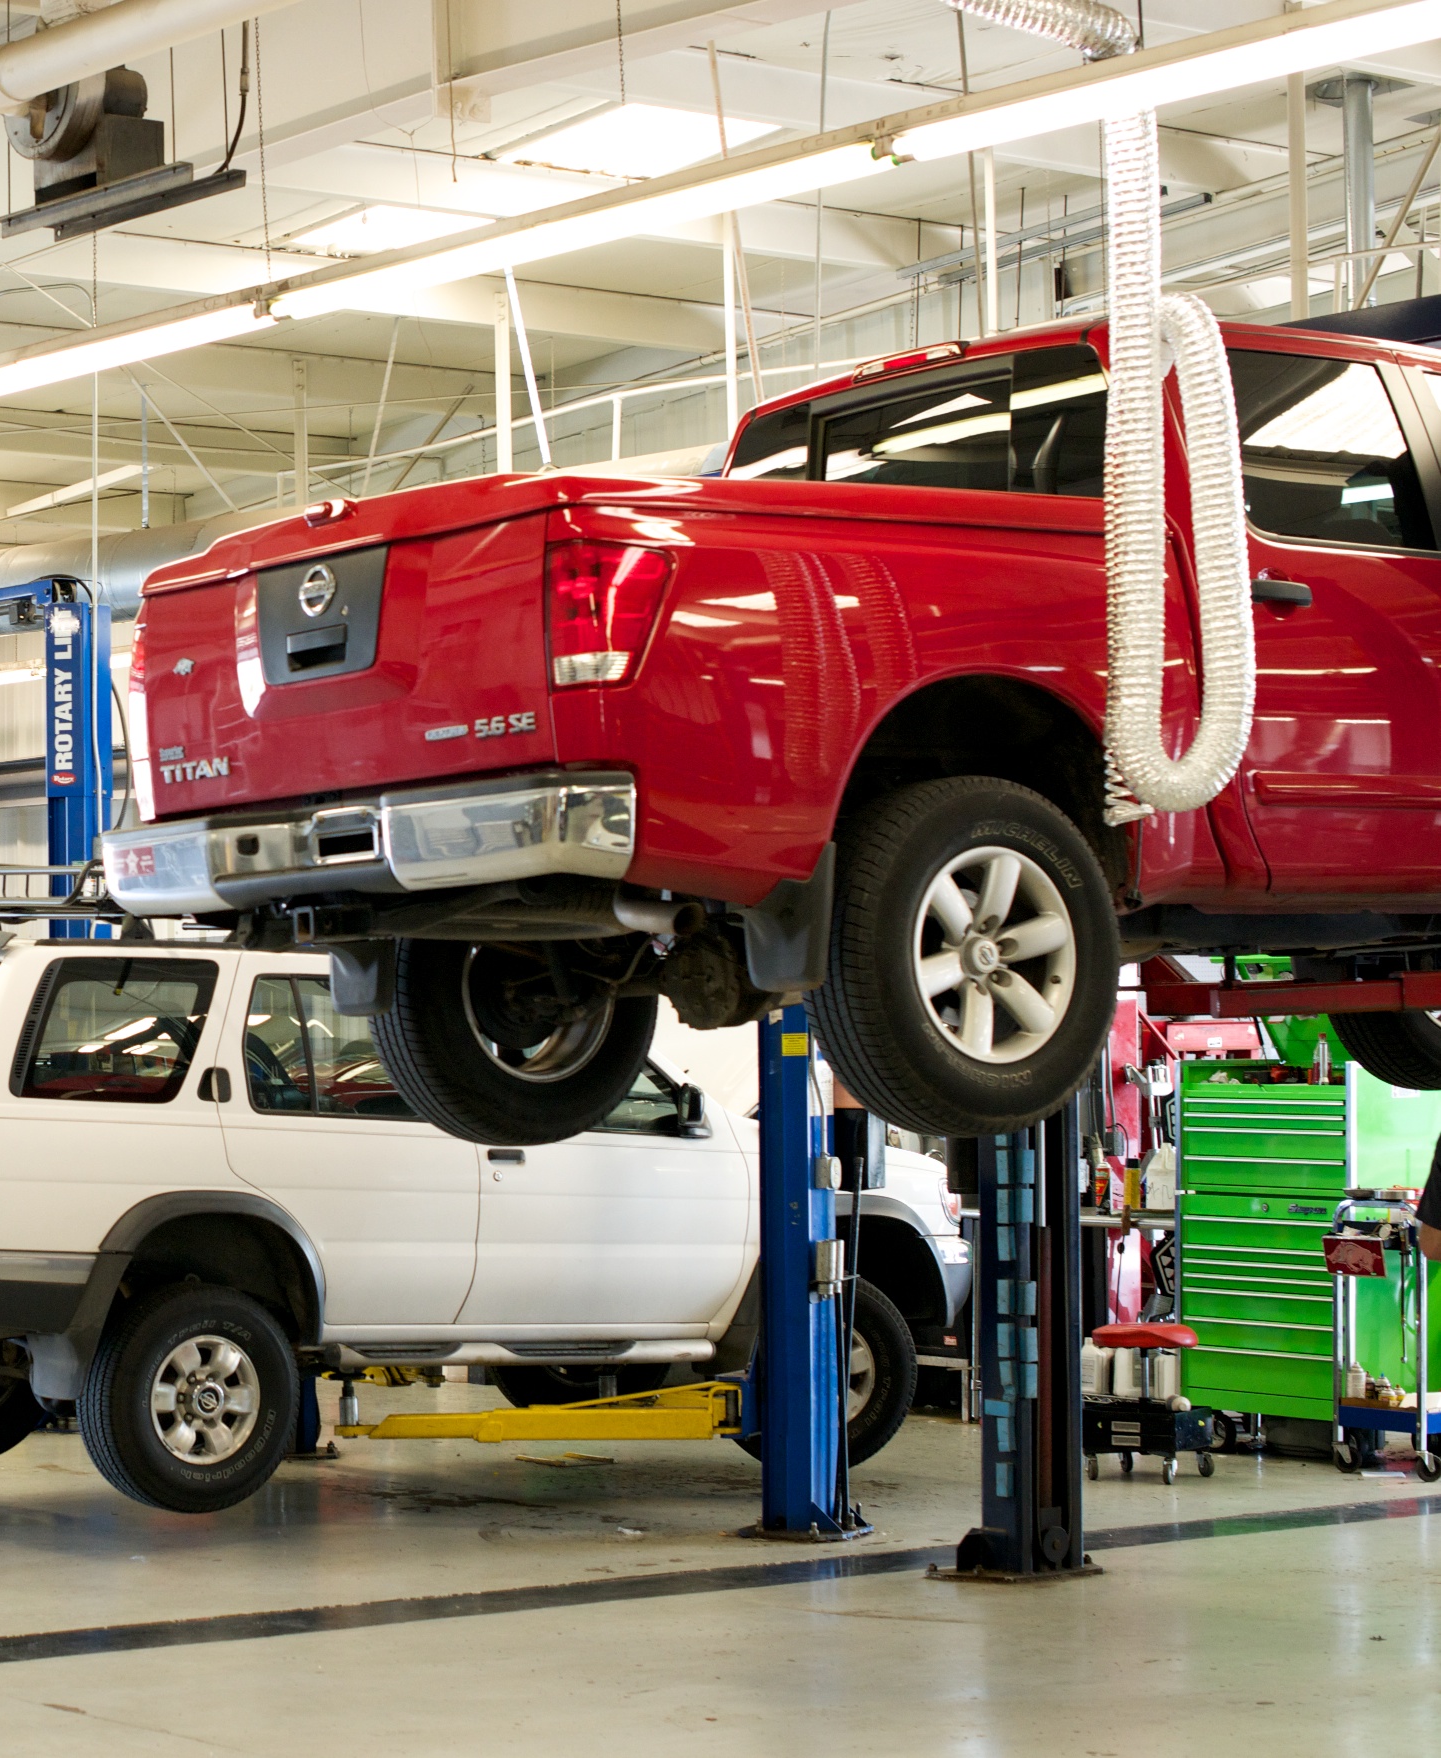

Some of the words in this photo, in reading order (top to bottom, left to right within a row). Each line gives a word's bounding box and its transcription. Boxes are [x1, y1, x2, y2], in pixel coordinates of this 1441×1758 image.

[54, 668, 72, 770] ROTARY
[474, 716, 506, 739] 5.6
[507, 711, 536, 734] SE
[160, 756, 230, 785] TITAN
[970, 819, 1084, 889] MICHELIN
